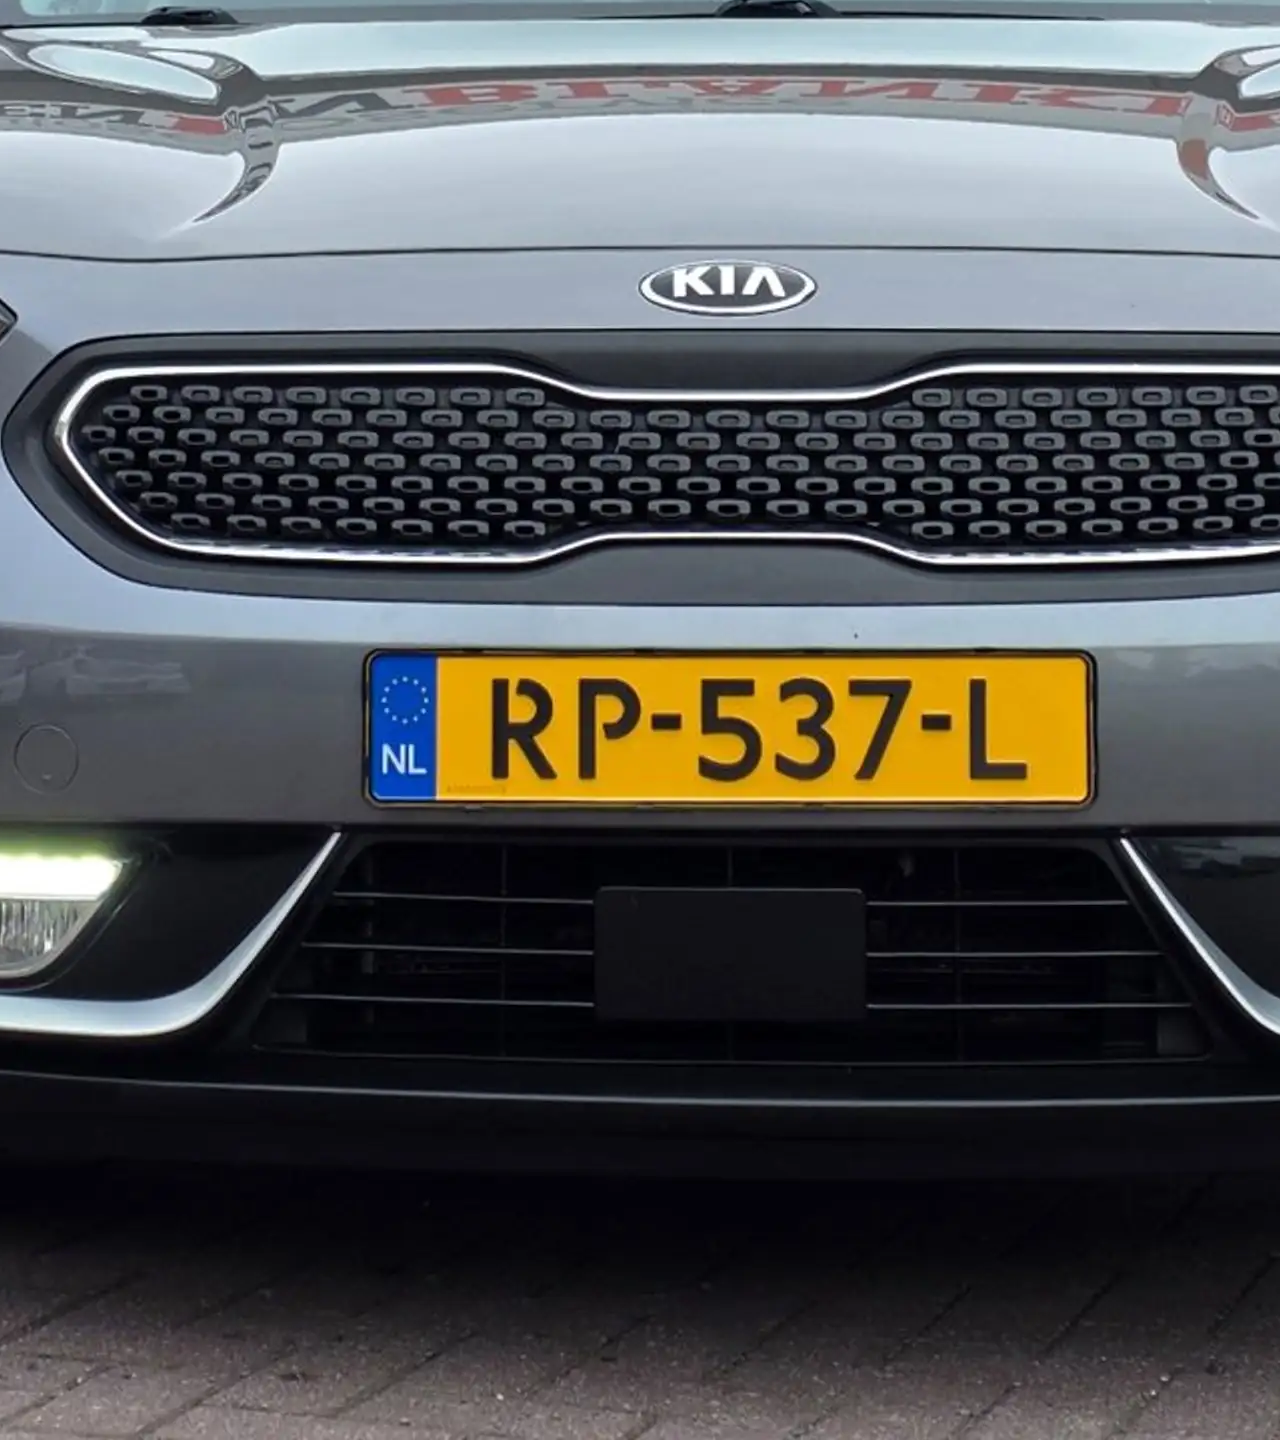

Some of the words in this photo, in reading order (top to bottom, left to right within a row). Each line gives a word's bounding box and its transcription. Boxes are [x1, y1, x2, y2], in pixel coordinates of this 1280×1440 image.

[673, 265, 787, 298] KIA
[490, 677, 1028, 782] RP-537-L
[382, 743, 428, 775] NL
